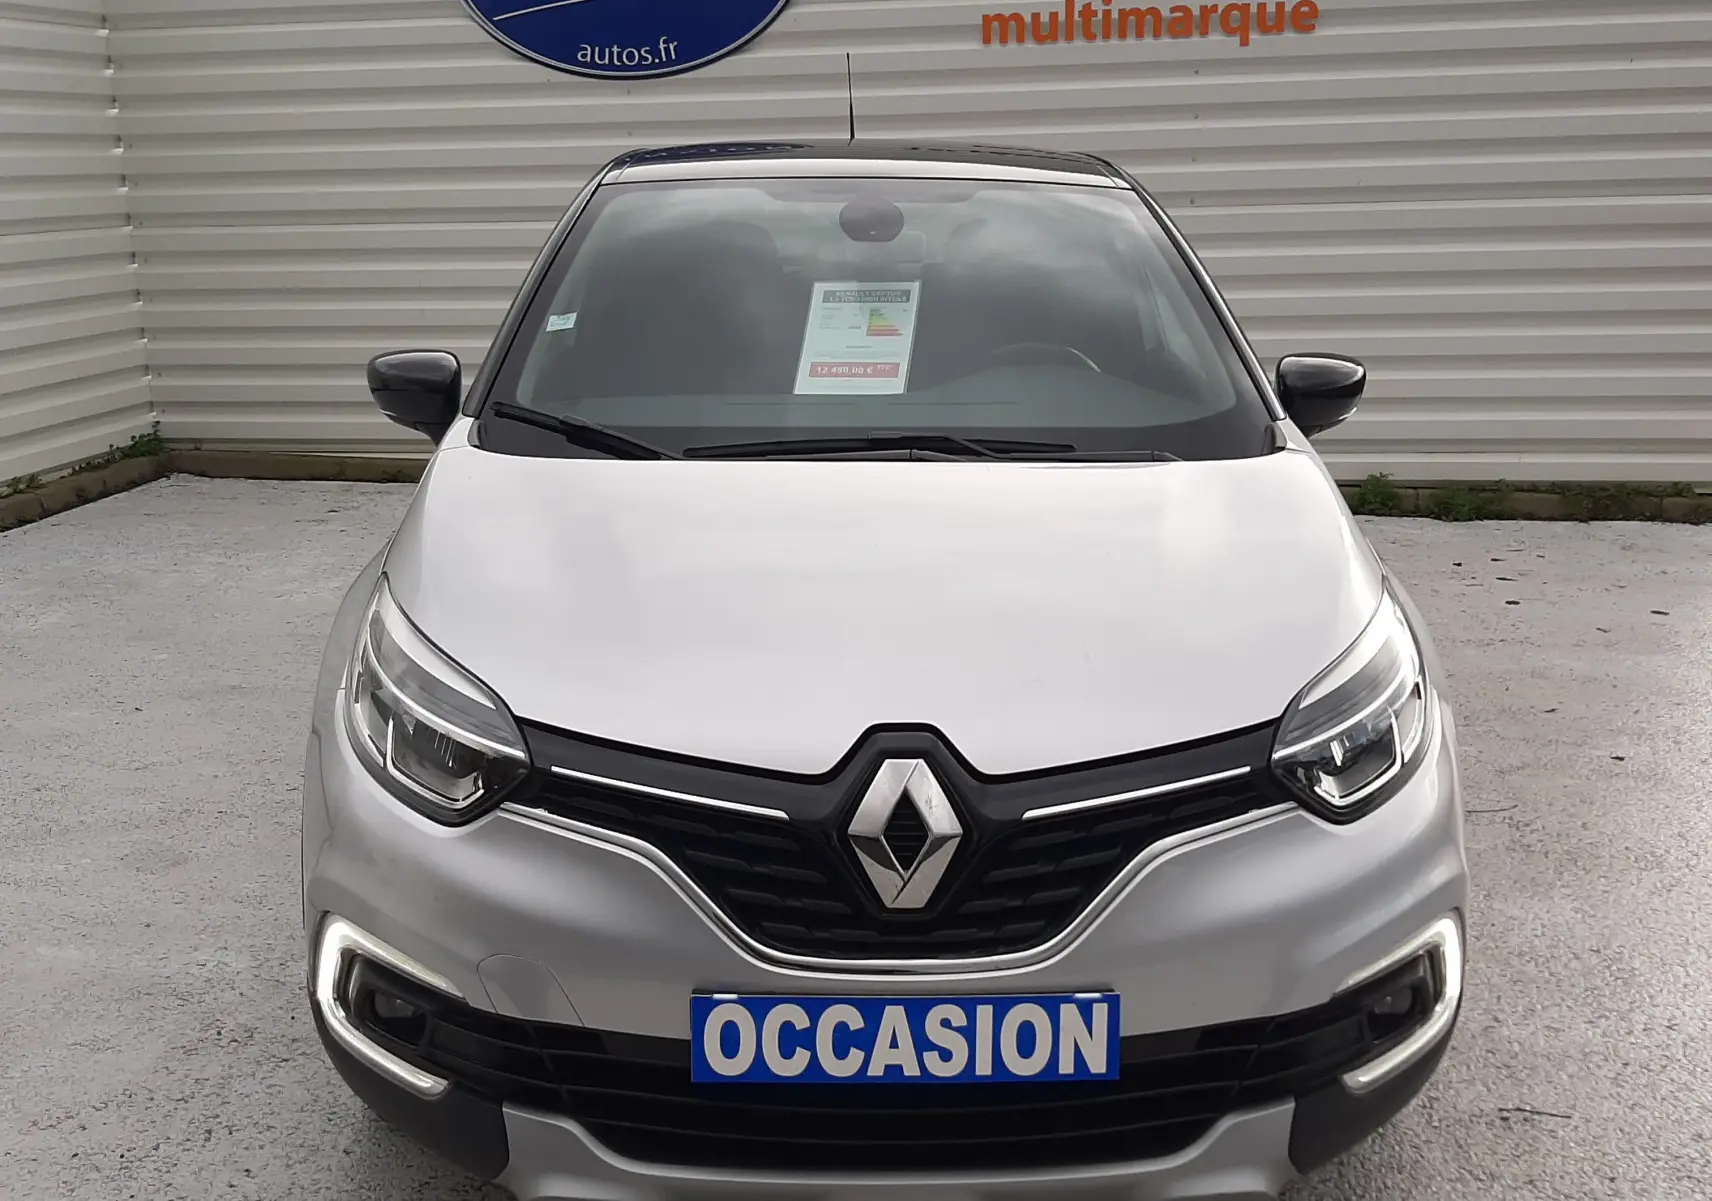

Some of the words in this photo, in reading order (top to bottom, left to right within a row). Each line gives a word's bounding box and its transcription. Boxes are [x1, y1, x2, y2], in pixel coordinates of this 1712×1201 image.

[981, 0, 1320, 47] multimarque
[577, 36, 679, 65] autos.fr
[817, 366, 828, 374] 12
[703, 1002, 1109, 1078] OCCASION
